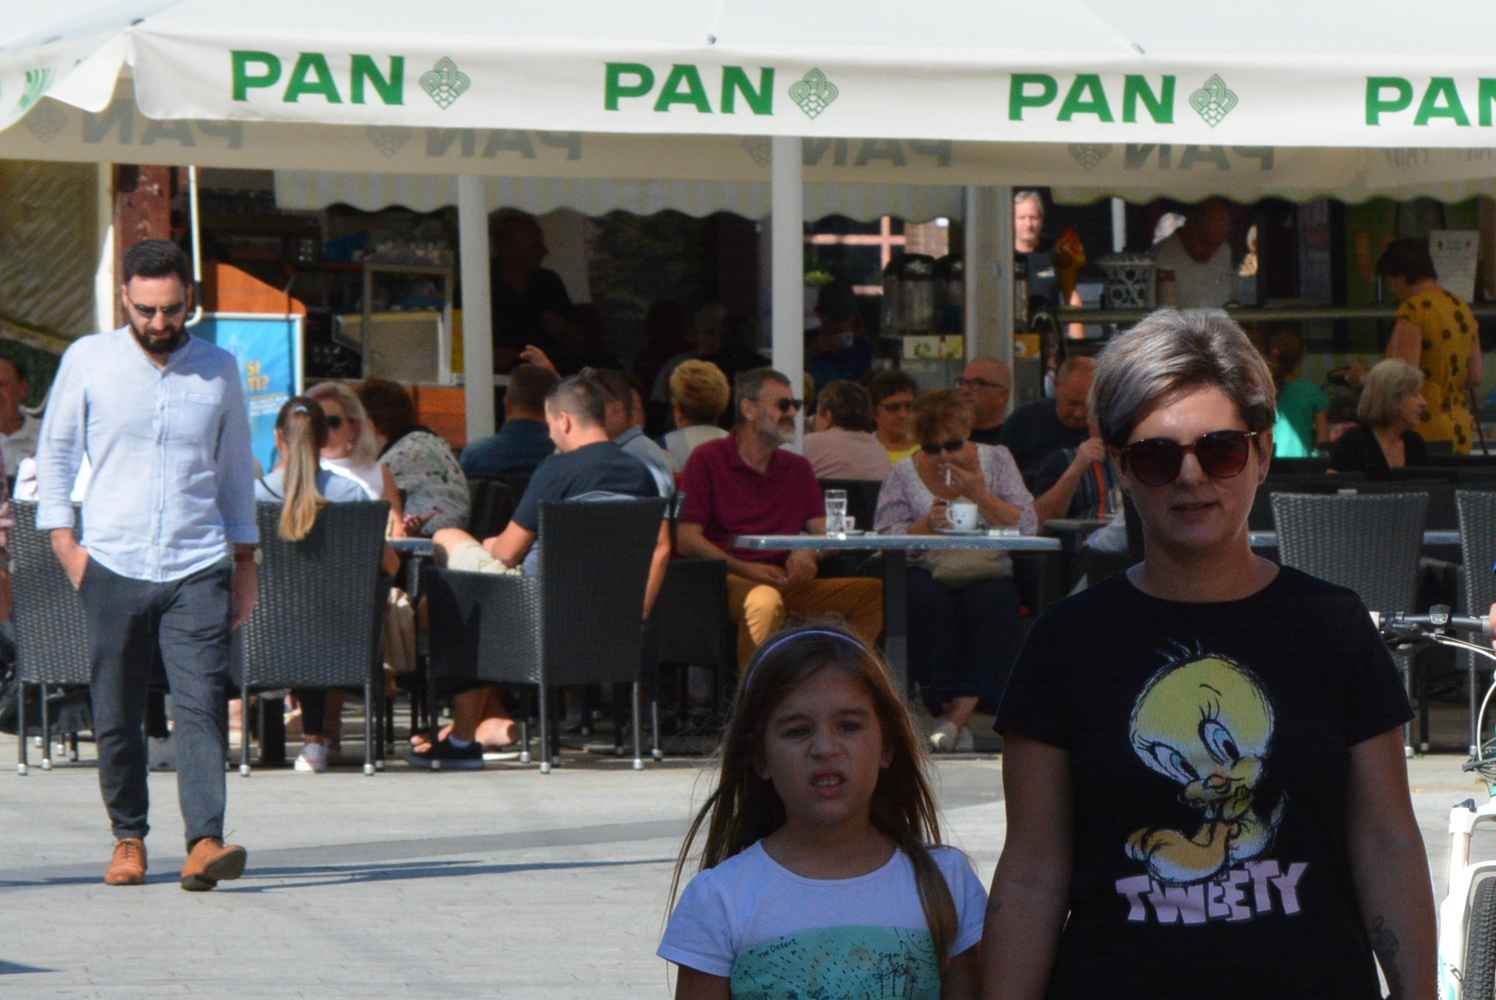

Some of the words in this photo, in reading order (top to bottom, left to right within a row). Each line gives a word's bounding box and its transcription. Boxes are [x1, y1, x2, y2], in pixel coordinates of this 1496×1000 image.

[230, 49, 405, 105] PAN
[604, 62, 775, 116] PAN
[1008, 73, 1177, 124] PAN
[1115, 860, 1310, 924] TWEETY
